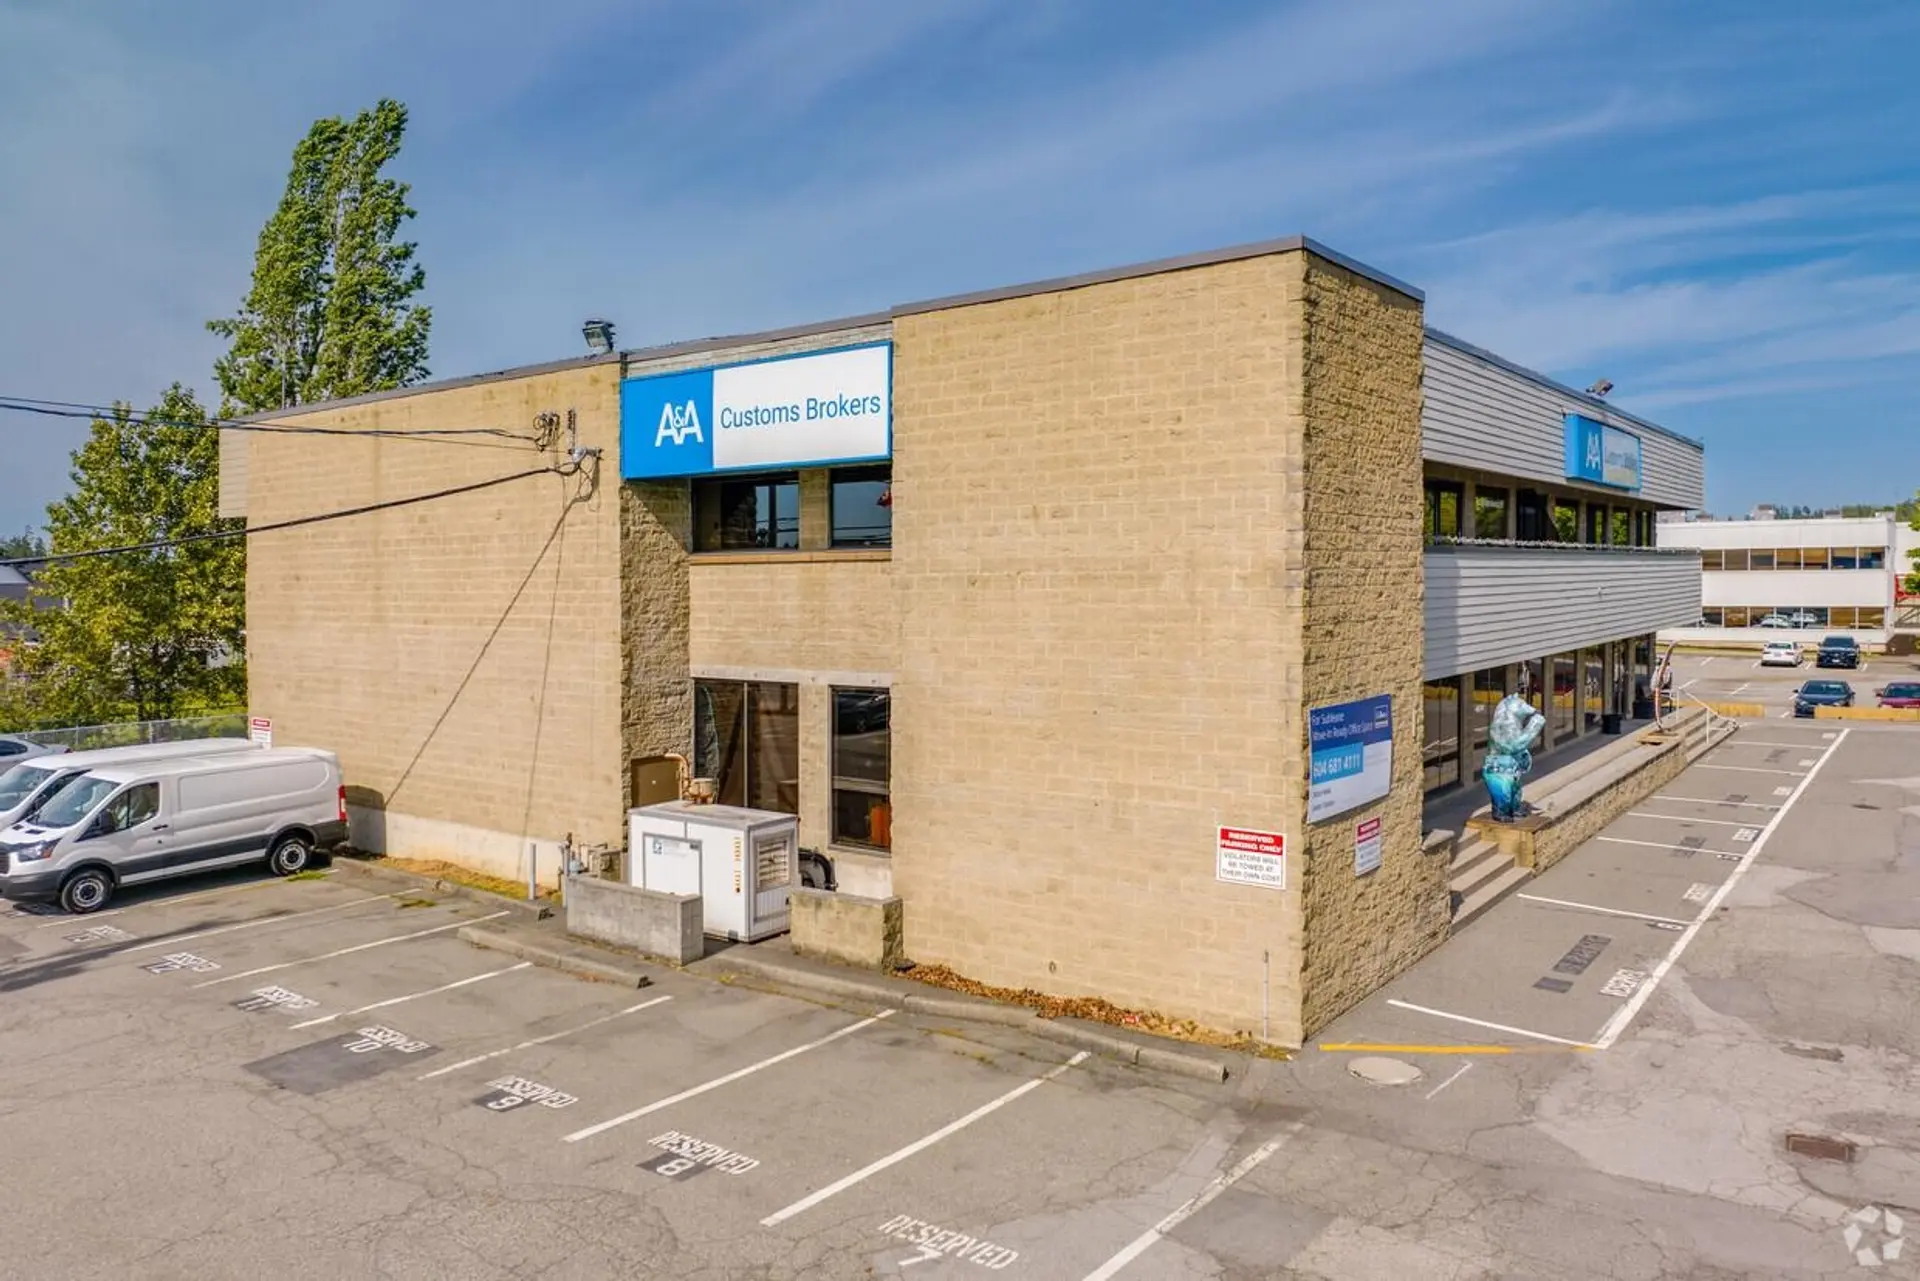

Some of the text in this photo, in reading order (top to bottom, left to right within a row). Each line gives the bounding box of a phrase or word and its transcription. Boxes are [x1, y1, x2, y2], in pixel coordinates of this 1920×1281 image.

[655, 393, 881, 448] A&A Customs Brokers
[1228, 832, 1275, 844] RESERVED
[1220, 839, 1282, 854] PARKING ONLY
[1223, 852, 1261, 863] VIOLATORS
[1239, 862, 1264, 872] TOWED
[1261, 873, 1281, 883] COST
[341, 1038, 383, 1054] 10
[486, 1096, 525, 1110] 9
[646, 1129, 760, 1175] RESERVED
[655, 1157, 696, 1176] 8
[876, 1213, 1021, 1270] RESERVED
[896, 1244, 943, 1267] 7
